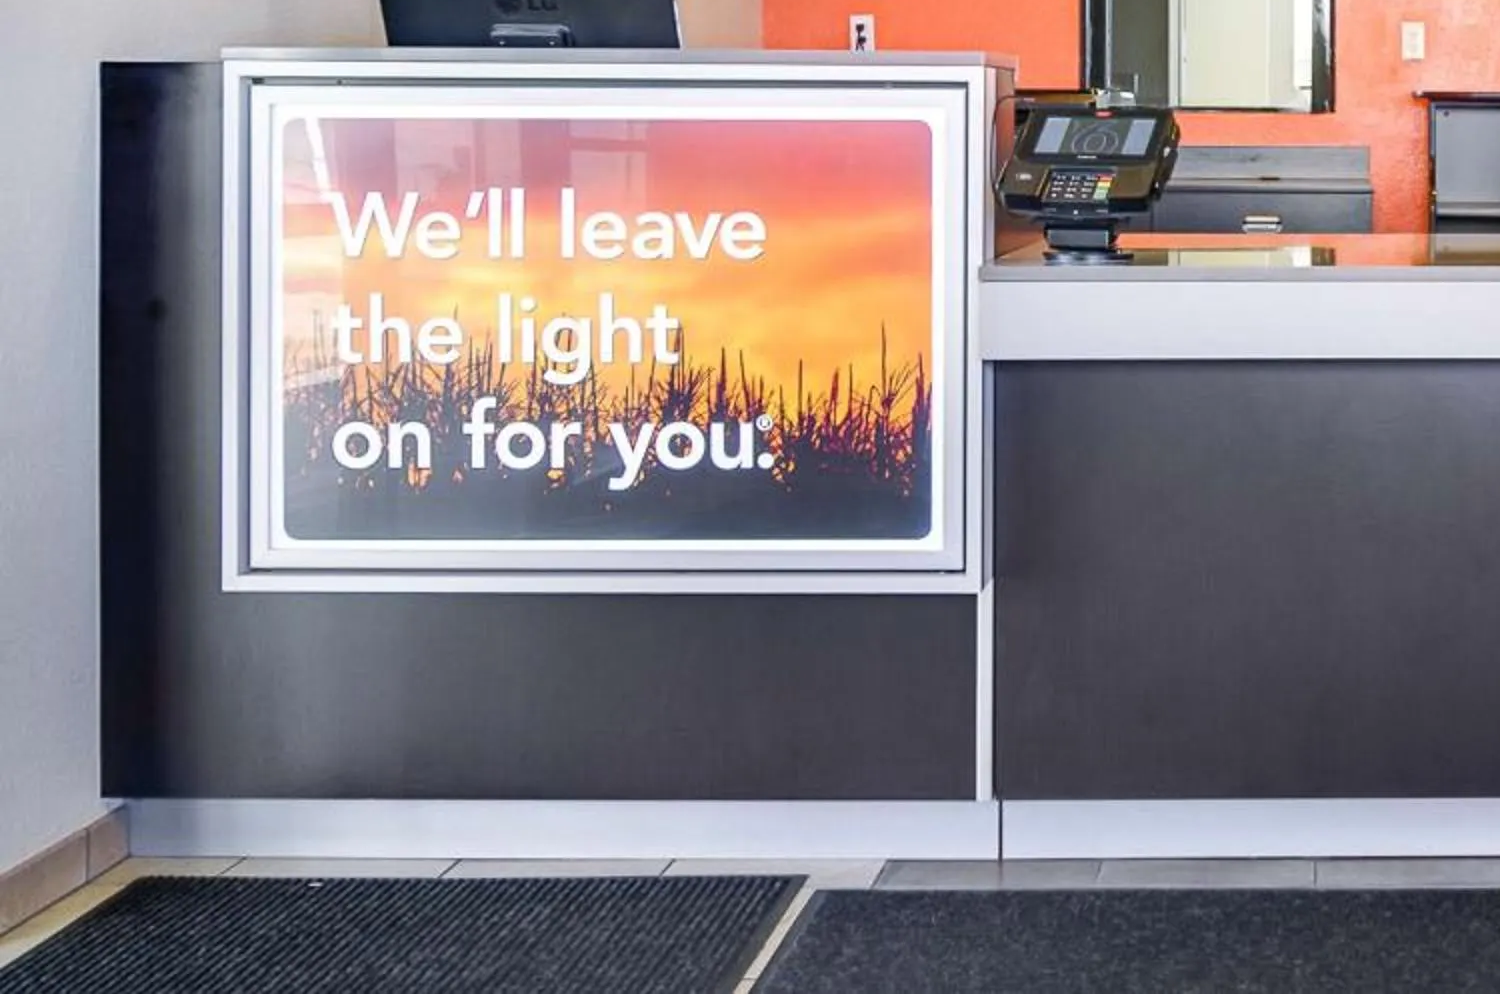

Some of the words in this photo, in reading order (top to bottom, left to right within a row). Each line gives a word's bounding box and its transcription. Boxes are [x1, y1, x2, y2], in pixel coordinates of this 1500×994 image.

[330, 187, 525, 260] We'll
[560, 188, 767, 260] leave
[333, 293, 463, 365] the
[498, 293, 681, 385] light
[332, 416, 430, 470] on
[463, 398, 583, 470] for
